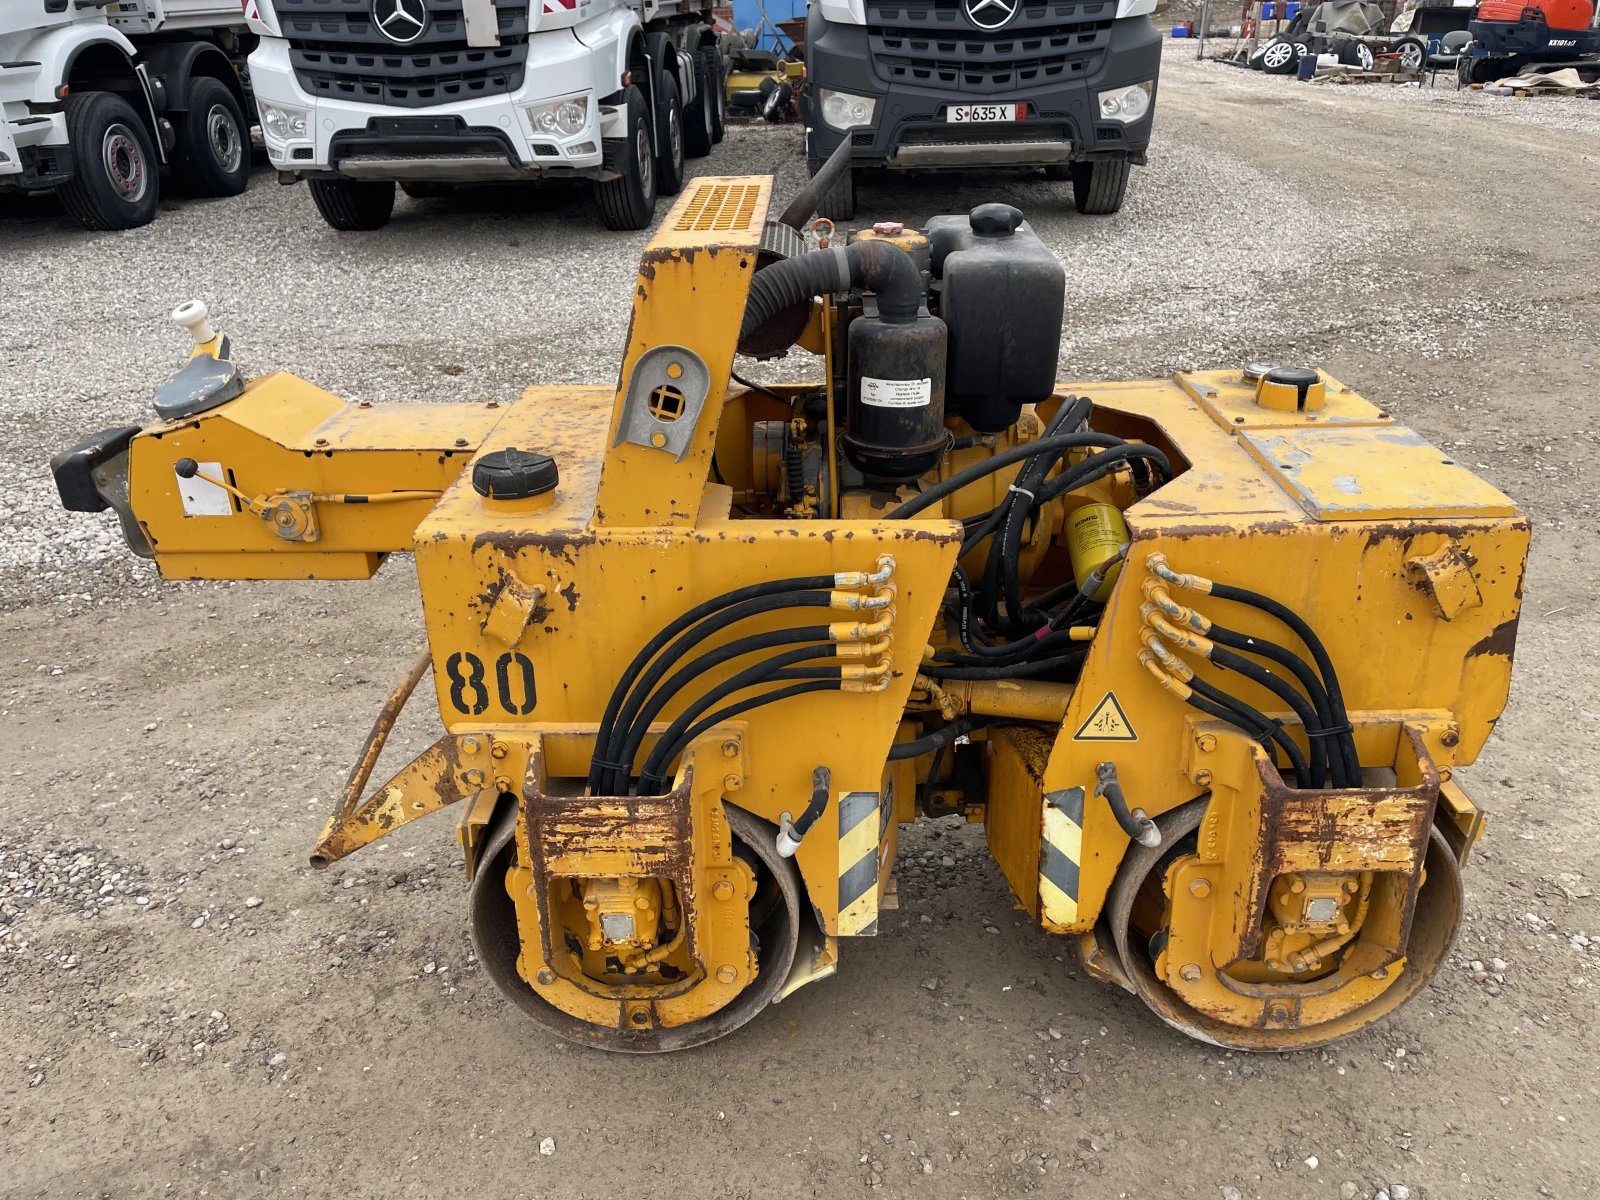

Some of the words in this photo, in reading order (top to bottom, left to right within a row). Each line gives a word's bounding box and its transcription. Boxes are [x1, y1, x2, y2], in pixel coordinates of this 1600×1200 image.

[955, 107, 964, 121] S
[972, 106, 996, 120] 635
[999, 106, 1007, 119] X
[1074, 515, 1098, 528] BOMAG
[446, 652, 537, 715] 80
